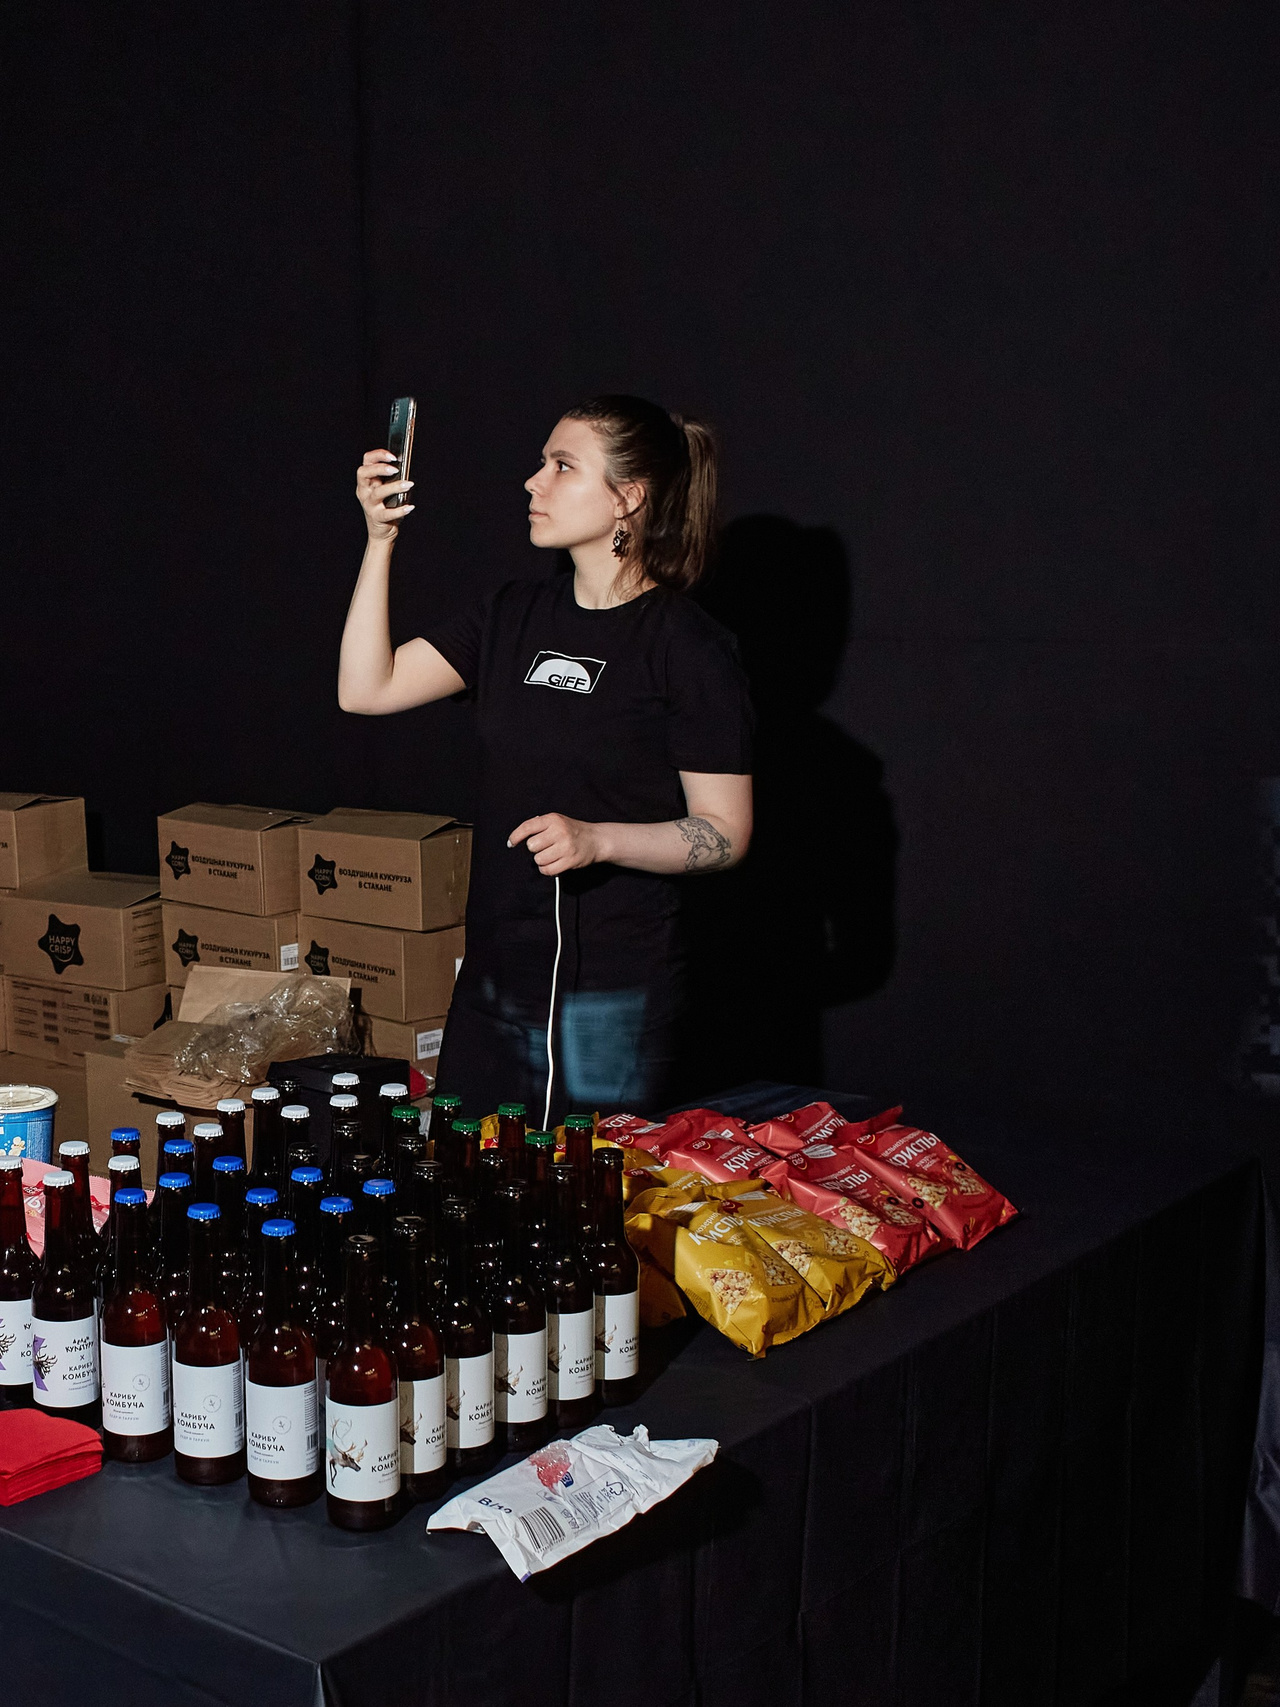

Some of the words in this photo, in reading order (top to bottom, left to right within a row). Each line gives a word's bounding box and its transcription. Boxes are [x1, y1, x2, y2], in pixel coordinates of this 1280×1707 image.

[548, 673, 587, 689] GIFF
[192, 855, 225, 867] ВОЗДУШНАЯ
[226, 860, 255, 871] КУКУРУЗА
[213, 869, 238, 879] СТАКАНЕ
[339, 868, 378, 880] ВОЗДУШНАЯ
[380, 874, 412, 883] КУКУРУЗА
[364, 882, 392, 892] СТАКАНЕ
[48, 935, 75, 946] HAPPY
[49, 944, 72, 955] CRISP
[201, 943, 238, 955] ВОЗДУШНАЯ
[239, 947, 270, 959] КУКУРУЗА
[224, 957, 251, 966] СТАКАНЕ
[332, 956, 366, 970] ВОЗДУШНАЯ
[367, 963, 396, 976] КУКУРУЗА
[353, 972, 378, 983] СТАКАНЕ
[886, 1132, 941, 1168] КРИСПЫ
[723, 1148, 762, 1173] КРИС
[69, 1362, 93, 1372] КАРИБУ
[110, 1392, 136, 1400] КАРИБУ
[106, 1398, 144, 1408] КОМБУЧА
[181, 1411, 207, 1421] КАРИБУ
[177, 1418, 215, 1430] КОМБУЧА
[251, 1432, 277, 1441] КАРИБУ
[248, 1438, 285, 1452] КОМБУЧА
